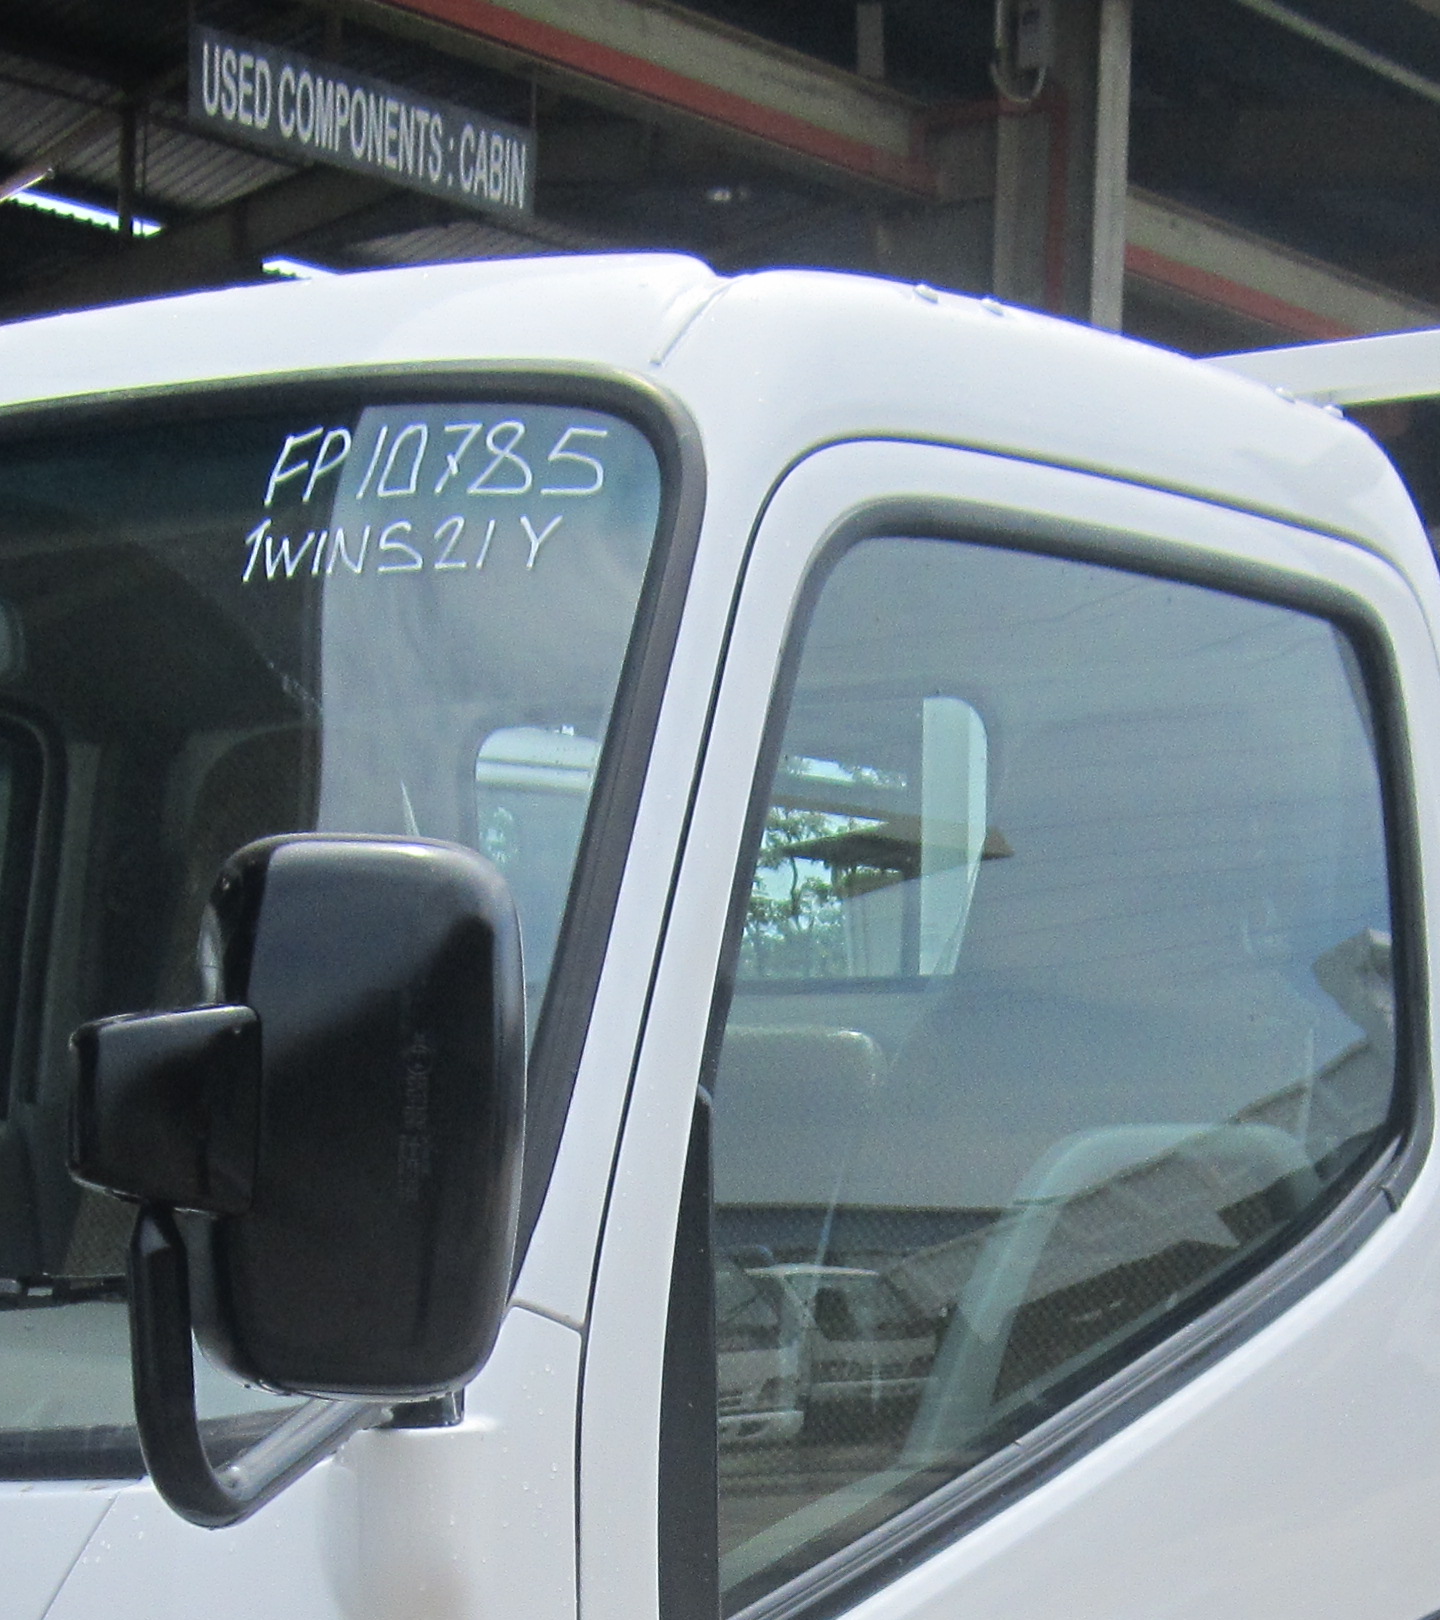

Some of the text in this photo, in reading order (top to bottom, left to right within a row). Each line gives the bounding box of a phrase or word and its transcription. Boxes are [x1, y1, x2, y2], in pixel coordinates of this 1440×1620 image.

[203, 42, 272, 130] USED
[278, 66, 443, 182] COMPONENTS
[460, 126, 527, 209] CABIN
